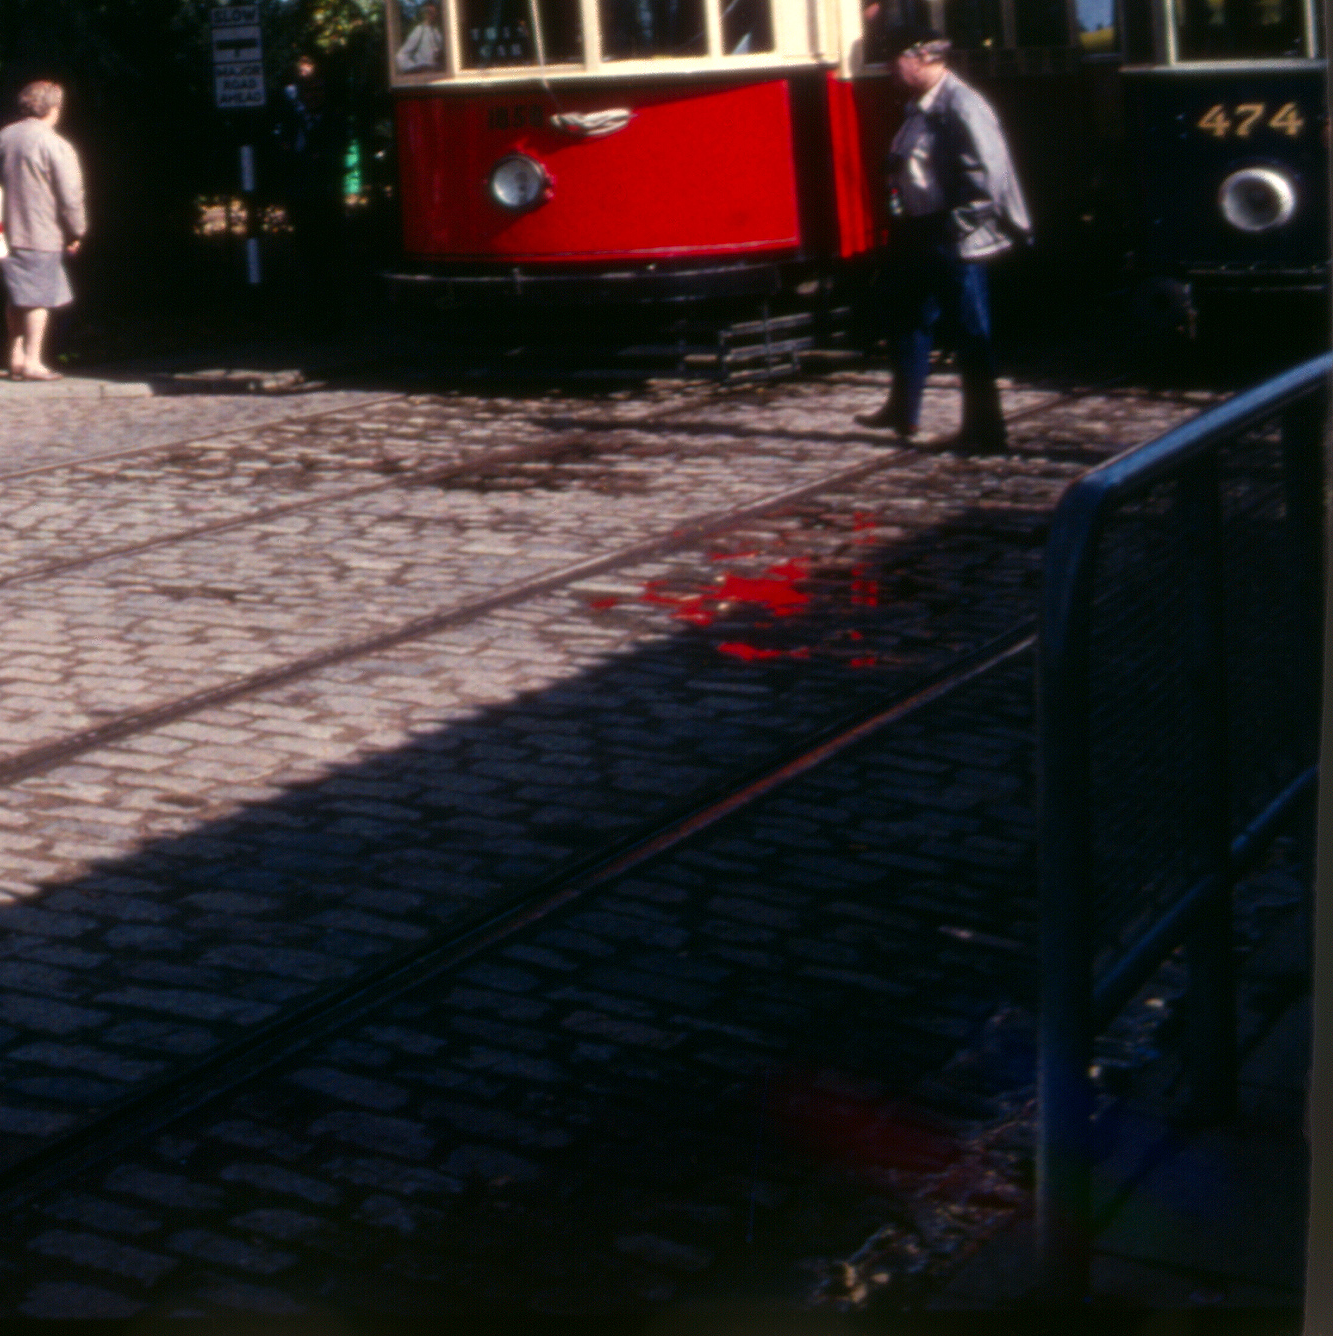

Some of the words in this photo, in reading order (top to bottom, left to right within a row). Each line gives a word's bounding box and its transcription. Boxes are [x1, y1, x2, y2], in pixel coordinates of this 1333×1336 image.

[213, 8, 258, 23] SLOW
[216, 65, 262, 77] MAJOR
[223, 79, 258, 90] ROAD
[219, 91, 263, 104] AHEAD
[1196, 101, 1305, 138] 474
